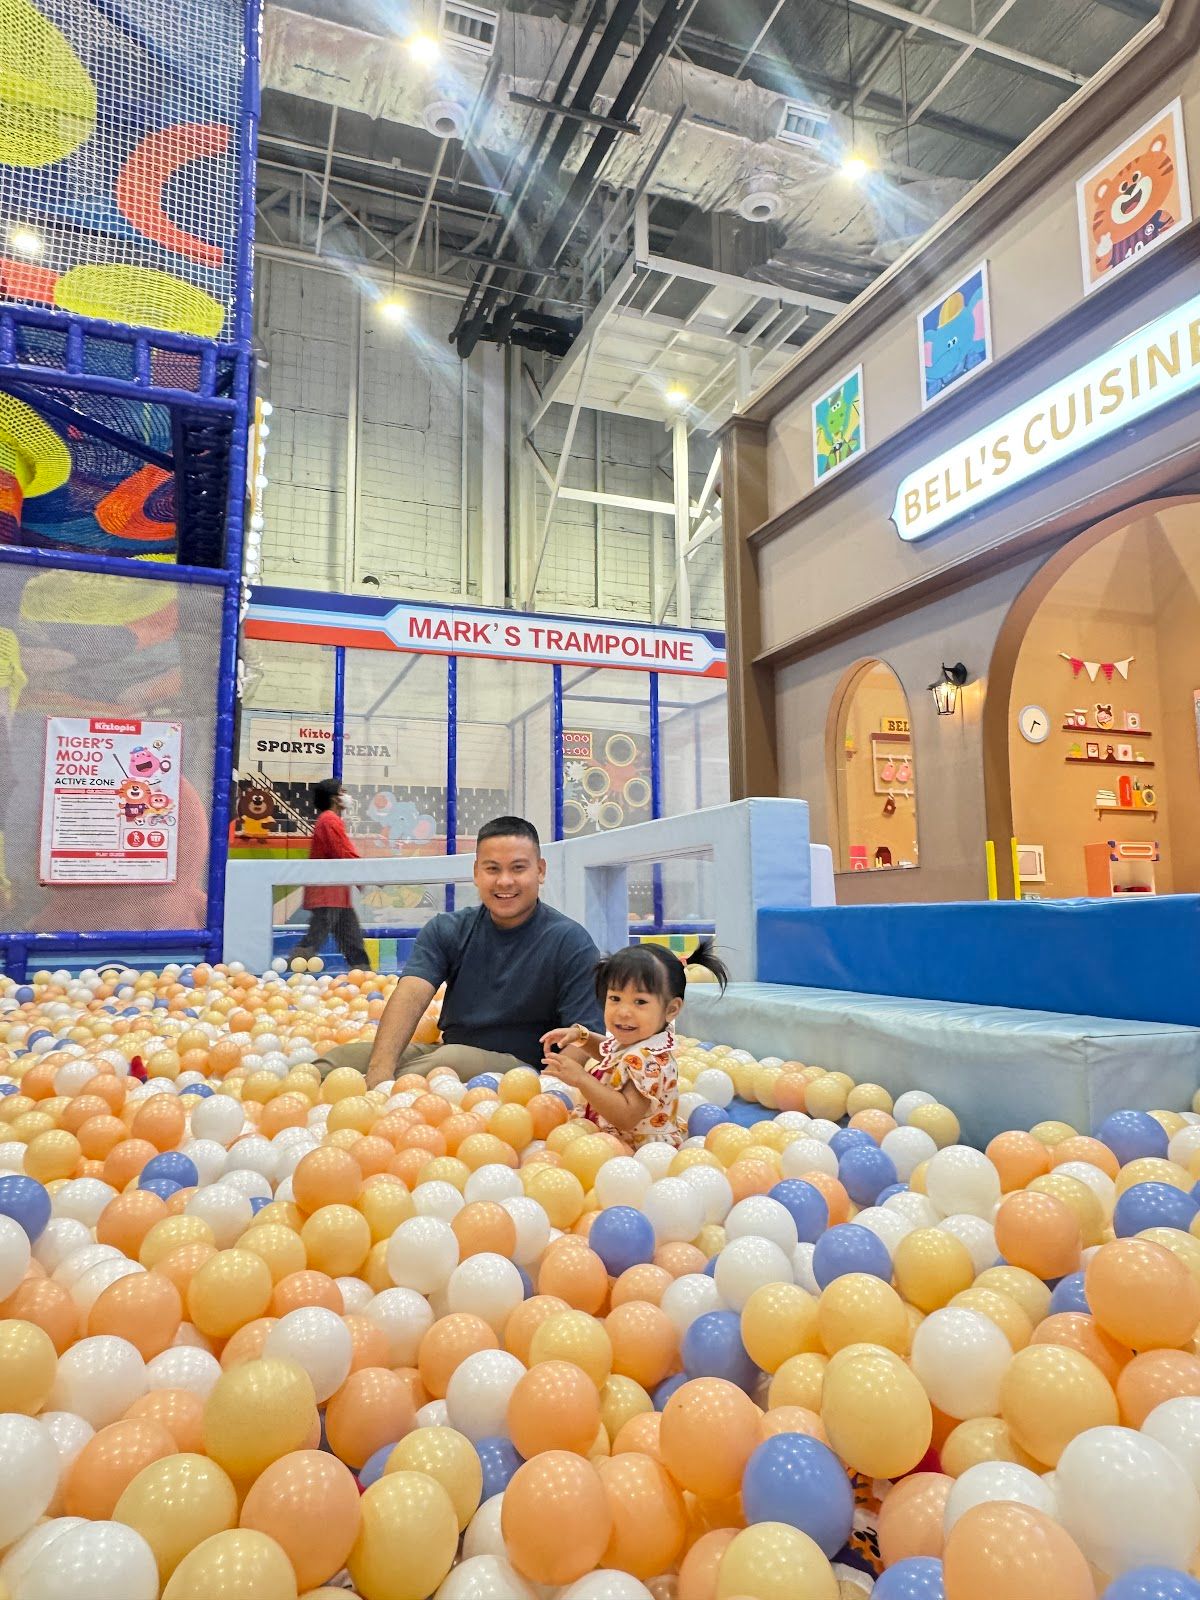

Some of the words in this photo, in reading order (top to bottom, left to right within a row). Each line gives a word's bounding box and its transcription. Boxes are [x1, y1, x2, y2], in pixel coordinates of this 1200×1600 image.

[903, 435, 1013, 526] BELL'S
[529, 628, 694, 662] TRAMPOLINE
[56, 750, 104, 763] MOJO
[256, 740, 326, 755] SPORTS
[332, 744, 391, 758] RENA
[55, 763, 99, 776] ZONE
[54, 777, 87, 786] ACTIVE
[89, 778, 115, 787] ZONE
